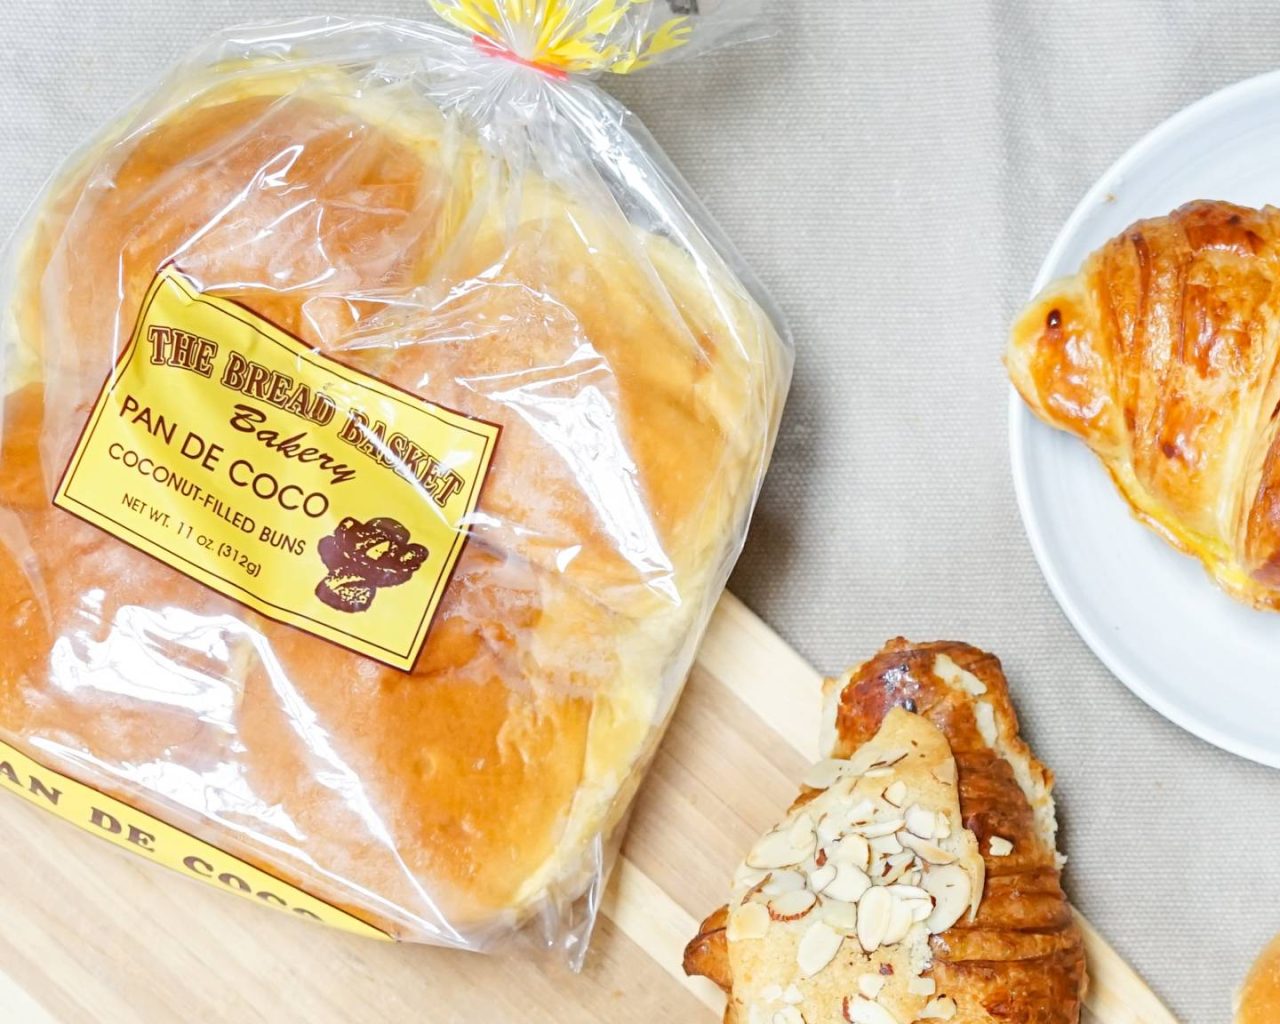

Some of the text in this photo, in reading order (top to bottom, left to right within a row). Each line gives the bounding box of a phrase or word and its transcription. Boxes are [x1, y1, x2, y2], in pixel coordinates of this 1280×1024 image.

[119, 395, 329, 518] PAN DE COCO
[147, 325, 465, 507] THE BREAD BASKET
[230, 404, 357, 484] Bakery
[108, 443, 306, 556] COCONUT-FILLED BUNS
[121, 493, 262, 578] NET WT. 11 oz. (312g)
[88, 807, 155, 853] DE
[183, 855, 323, 921] COC
